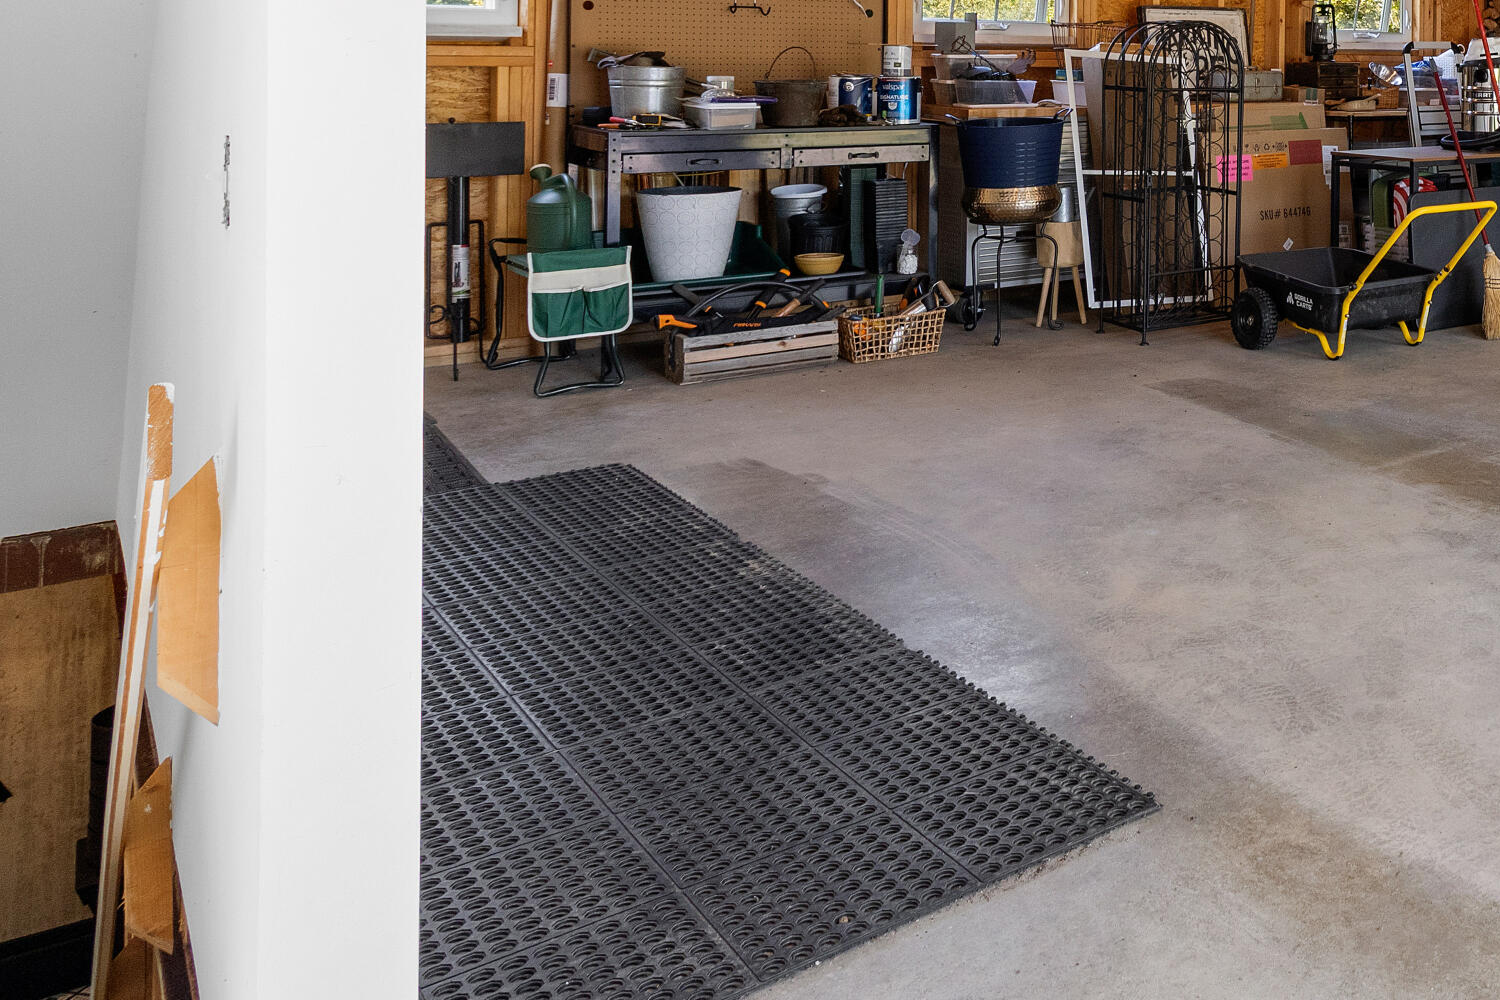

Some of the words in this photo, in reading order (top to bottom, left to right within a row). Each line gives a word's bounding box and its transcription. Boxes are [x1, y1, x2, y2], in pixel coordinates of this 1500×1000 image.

[882, 82, 905, 92] valspar
[1259, 207, 1281, 221] SKU#
[1294, 292, 1313, 304] GORILLA
[1296, 300, 1313, 311] CARTS
